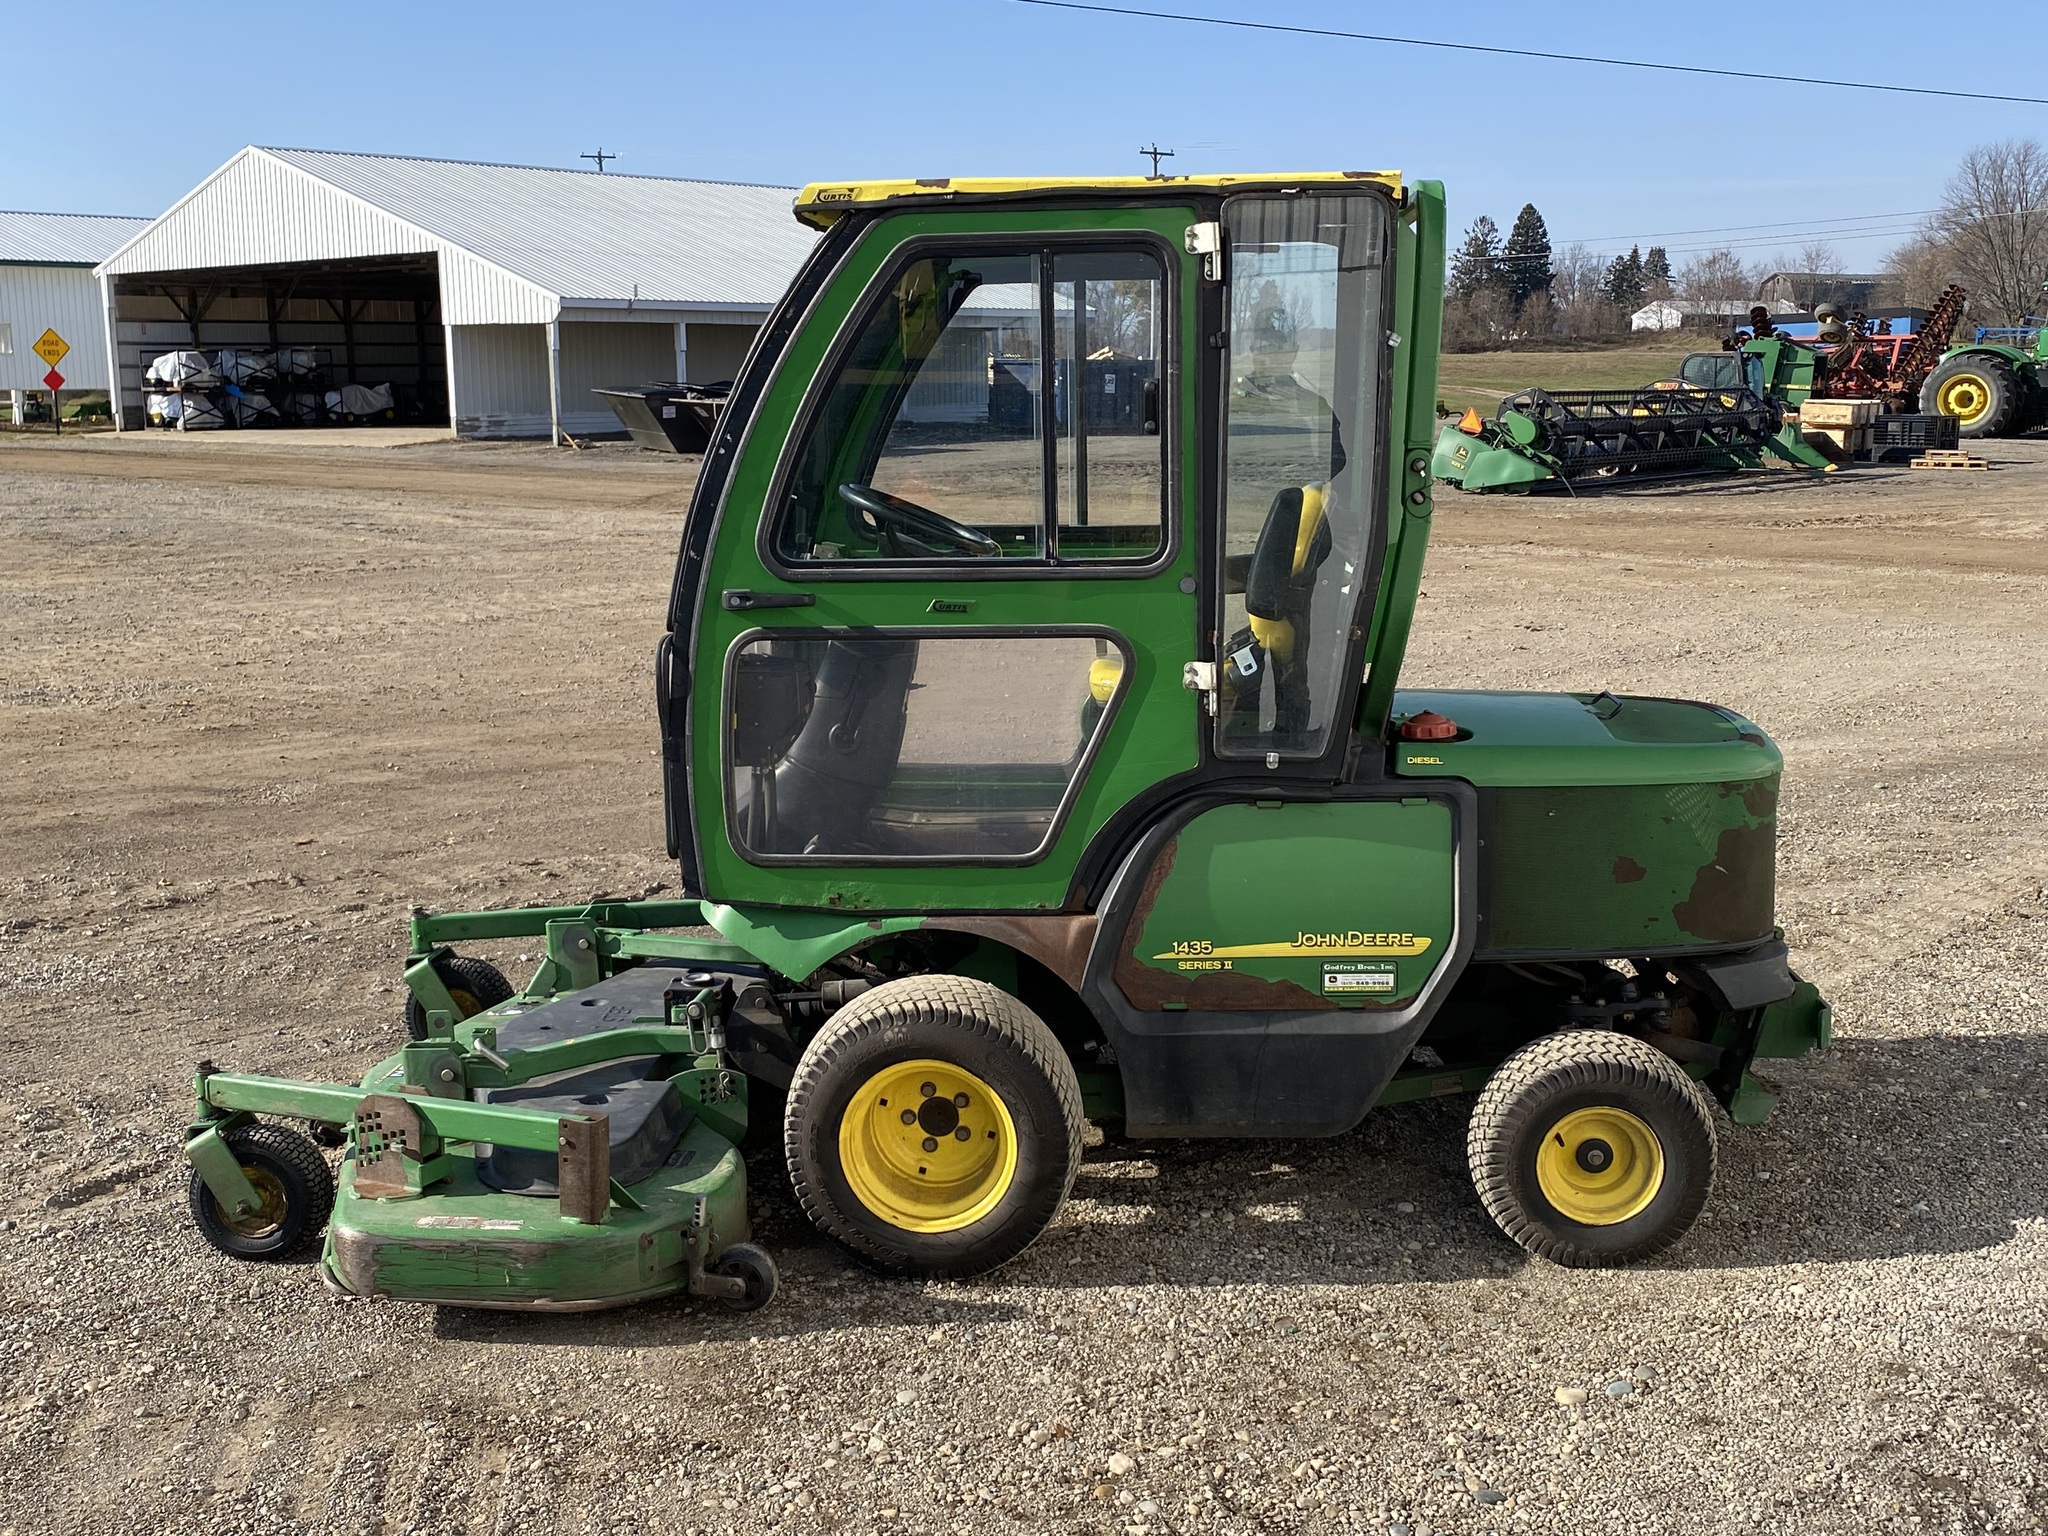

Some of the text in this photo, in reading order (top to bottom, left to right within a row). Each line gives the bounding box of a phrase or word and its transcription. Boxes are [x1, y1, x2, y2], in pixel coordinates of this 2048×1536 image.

[817, 188, 853, 202] CURTIS
[932, 600, 968, 613] CURTIS
[1291, 930, 1414, 947] JOHN DEERE
[1172, 940, 1213, 954] 1435
[1178, 961, 1233, 970] SERIES II
[1323, 963, 1356, 972] Godfrey
